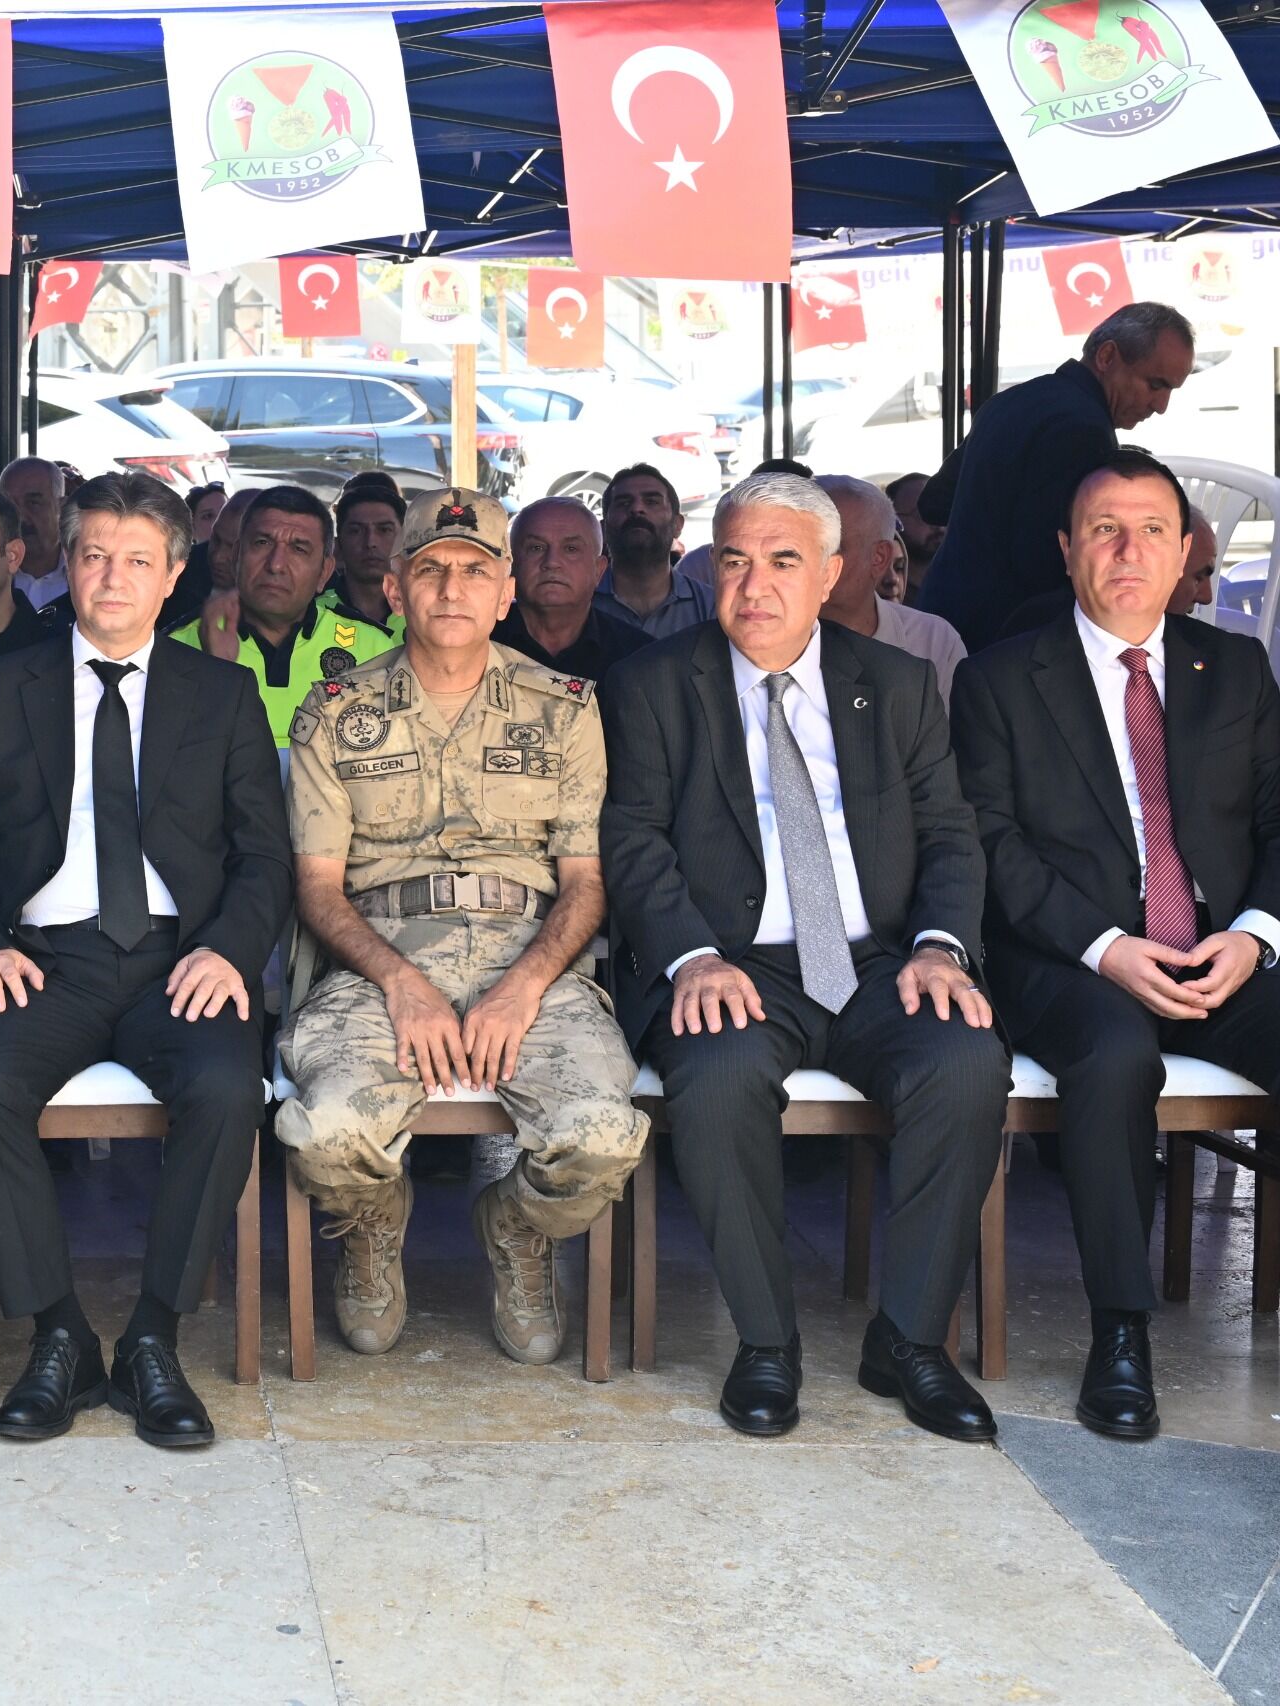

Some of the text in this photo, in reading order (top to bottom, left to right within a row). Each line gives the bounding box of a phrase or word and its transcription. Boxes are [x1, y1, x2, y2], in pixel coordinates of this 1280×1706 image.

[1048, 74, 1165, 121] KMESOB
[1107, 106, 1156, 128] 1952
[226, 148, 341, 178] KMESOB
[275, 177, 321, 193] 1952
[349, 758, 404, 775] GÜLECEN
